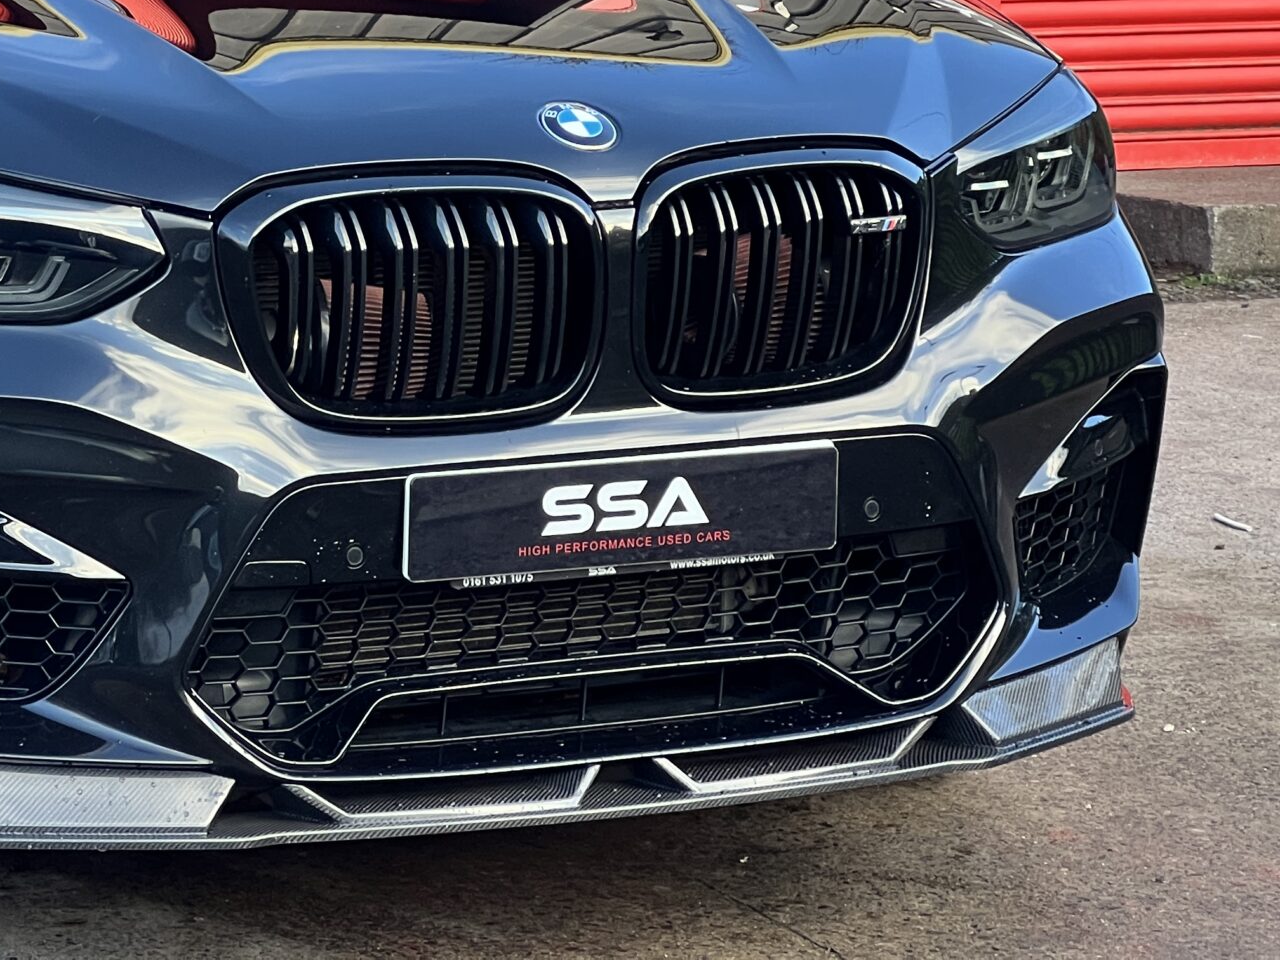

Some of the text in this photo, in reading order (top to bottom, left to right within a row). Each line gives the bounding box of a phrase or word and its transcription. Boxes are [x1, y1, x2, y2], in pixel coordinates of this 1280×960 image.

[541, 476, 710, 537] SSA
[518, 530, 731, 557] HIGH PERFORMANCE USED CARS
[588, 566, 617, 576] SSA
